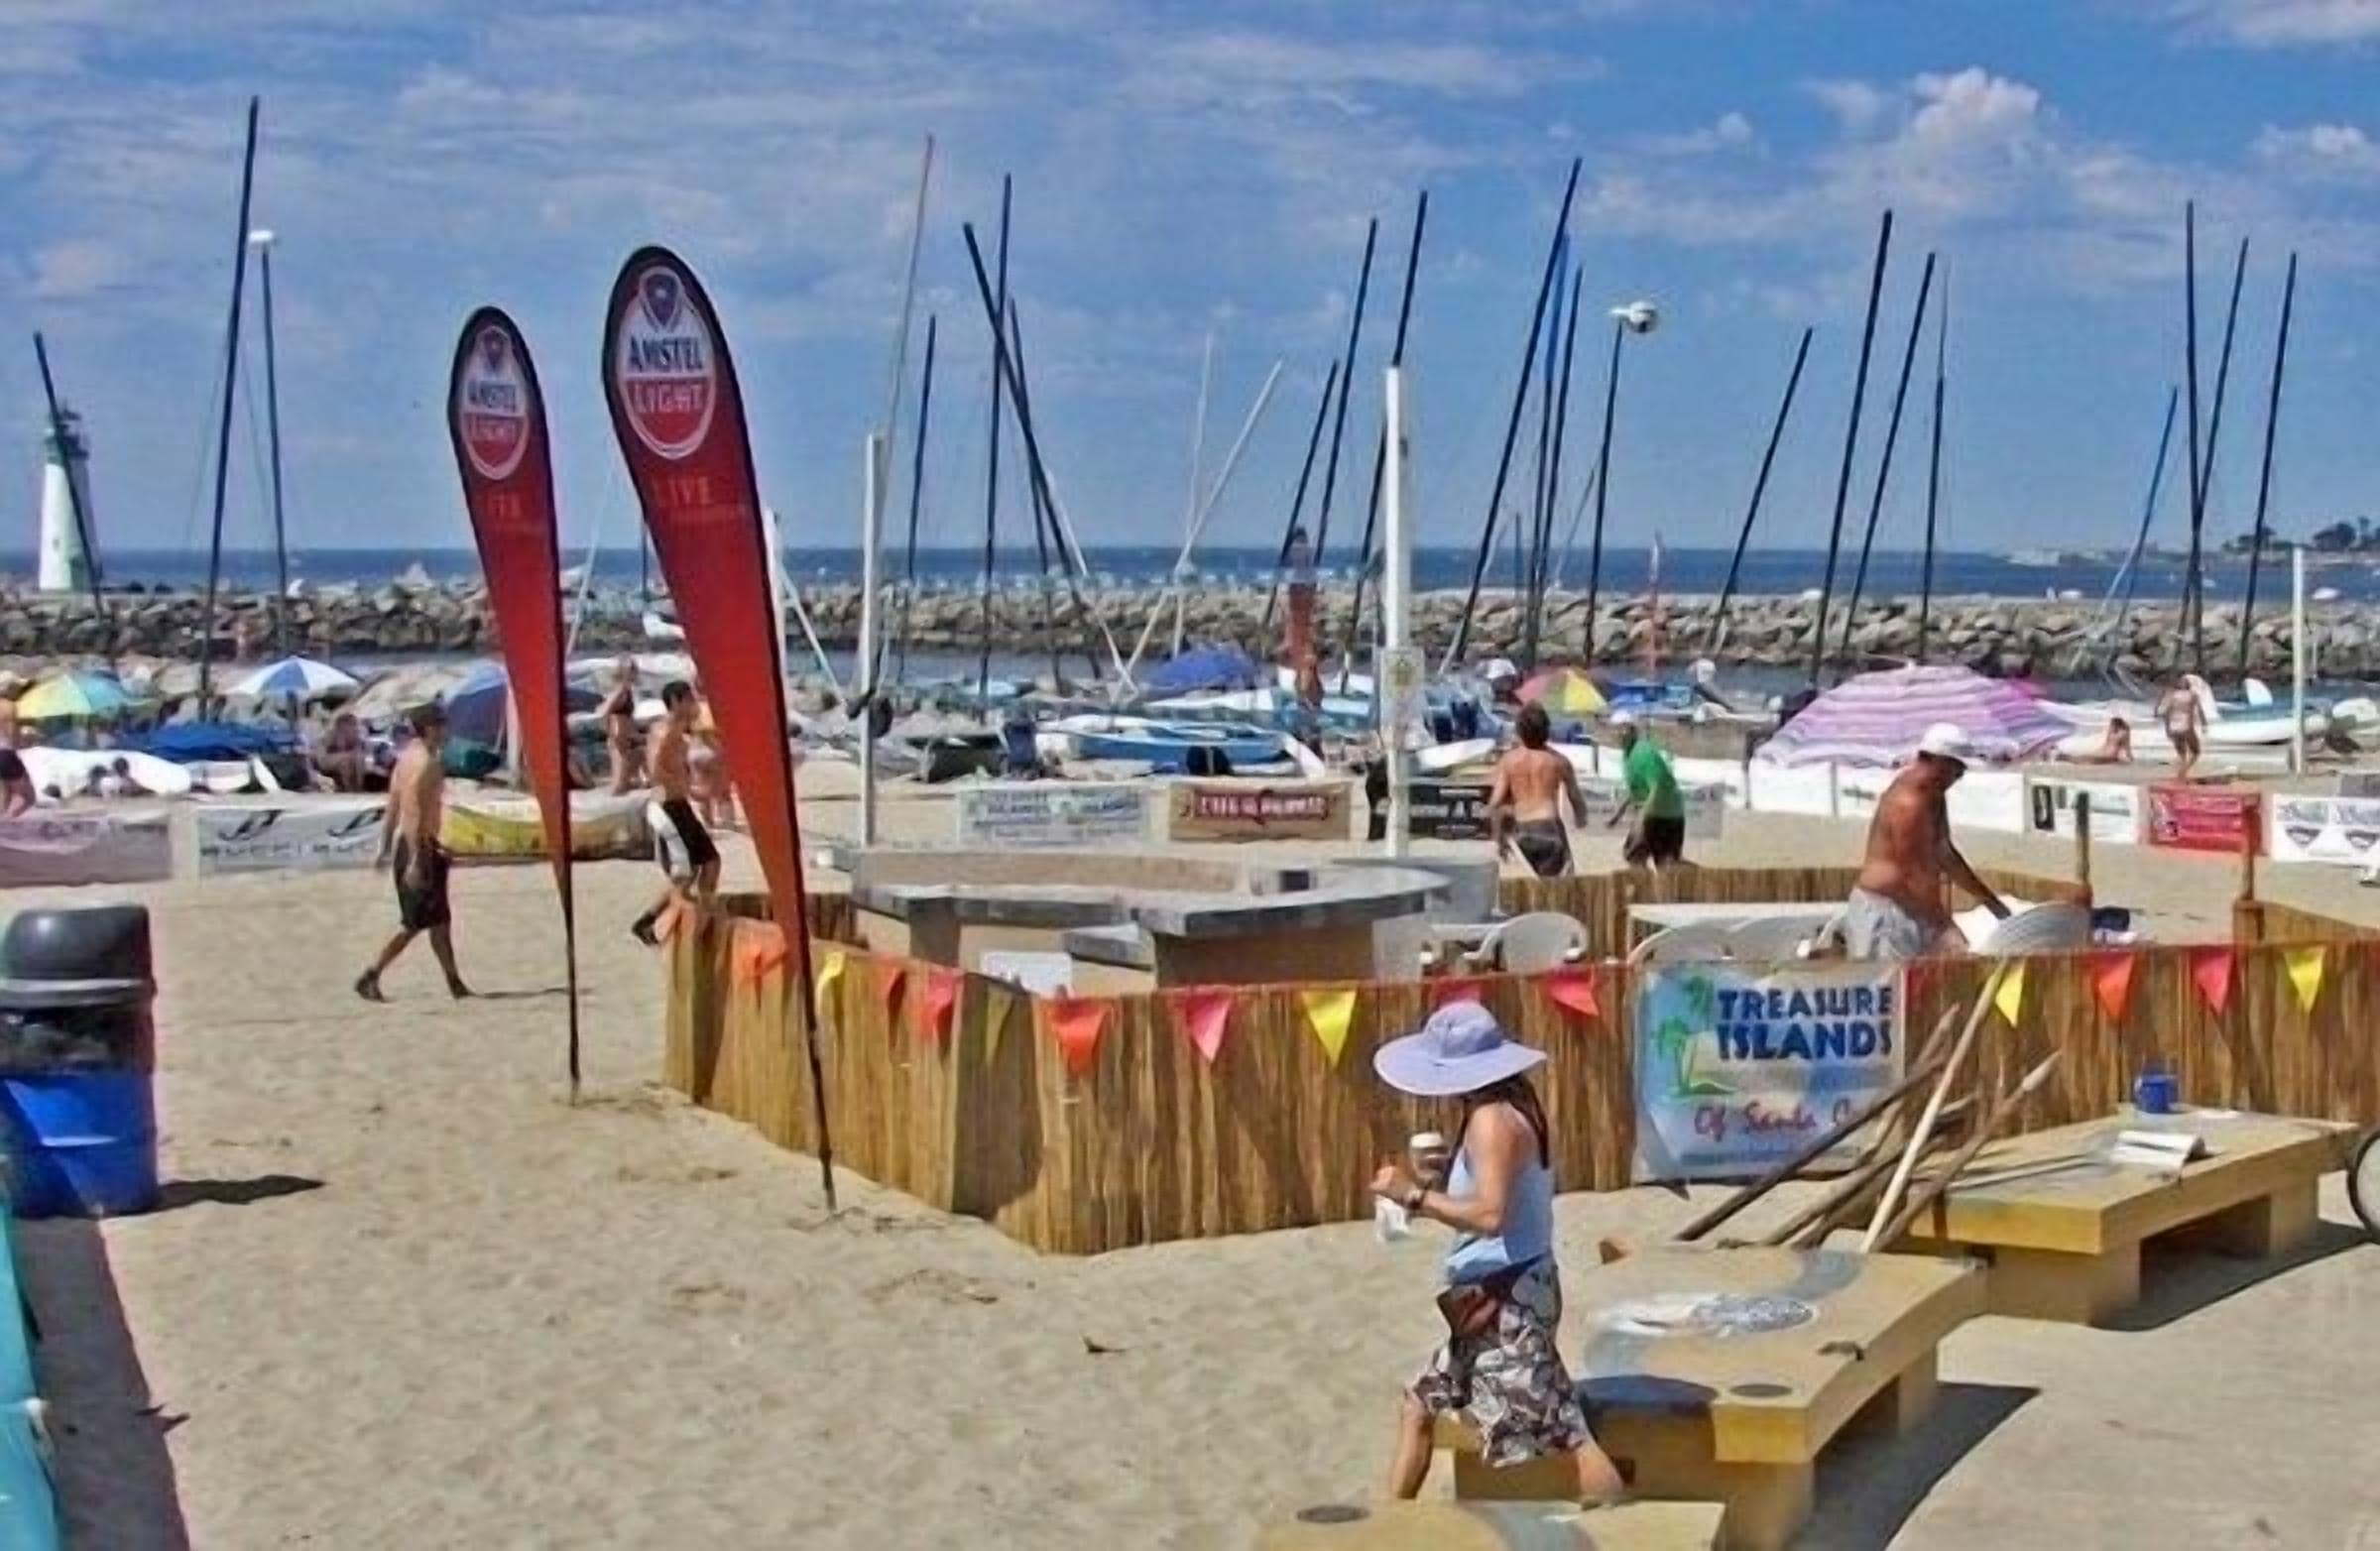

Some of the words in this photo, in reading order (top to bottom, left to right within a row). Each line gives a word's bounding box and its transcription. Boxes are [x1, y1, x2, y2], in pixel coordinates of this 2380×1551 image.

[629, 336, 703, 371] AMSTEL
[1717, 987, 1893, 1019] TREASURE
[1716, 1019, 1892, 1061] ISLANDS
